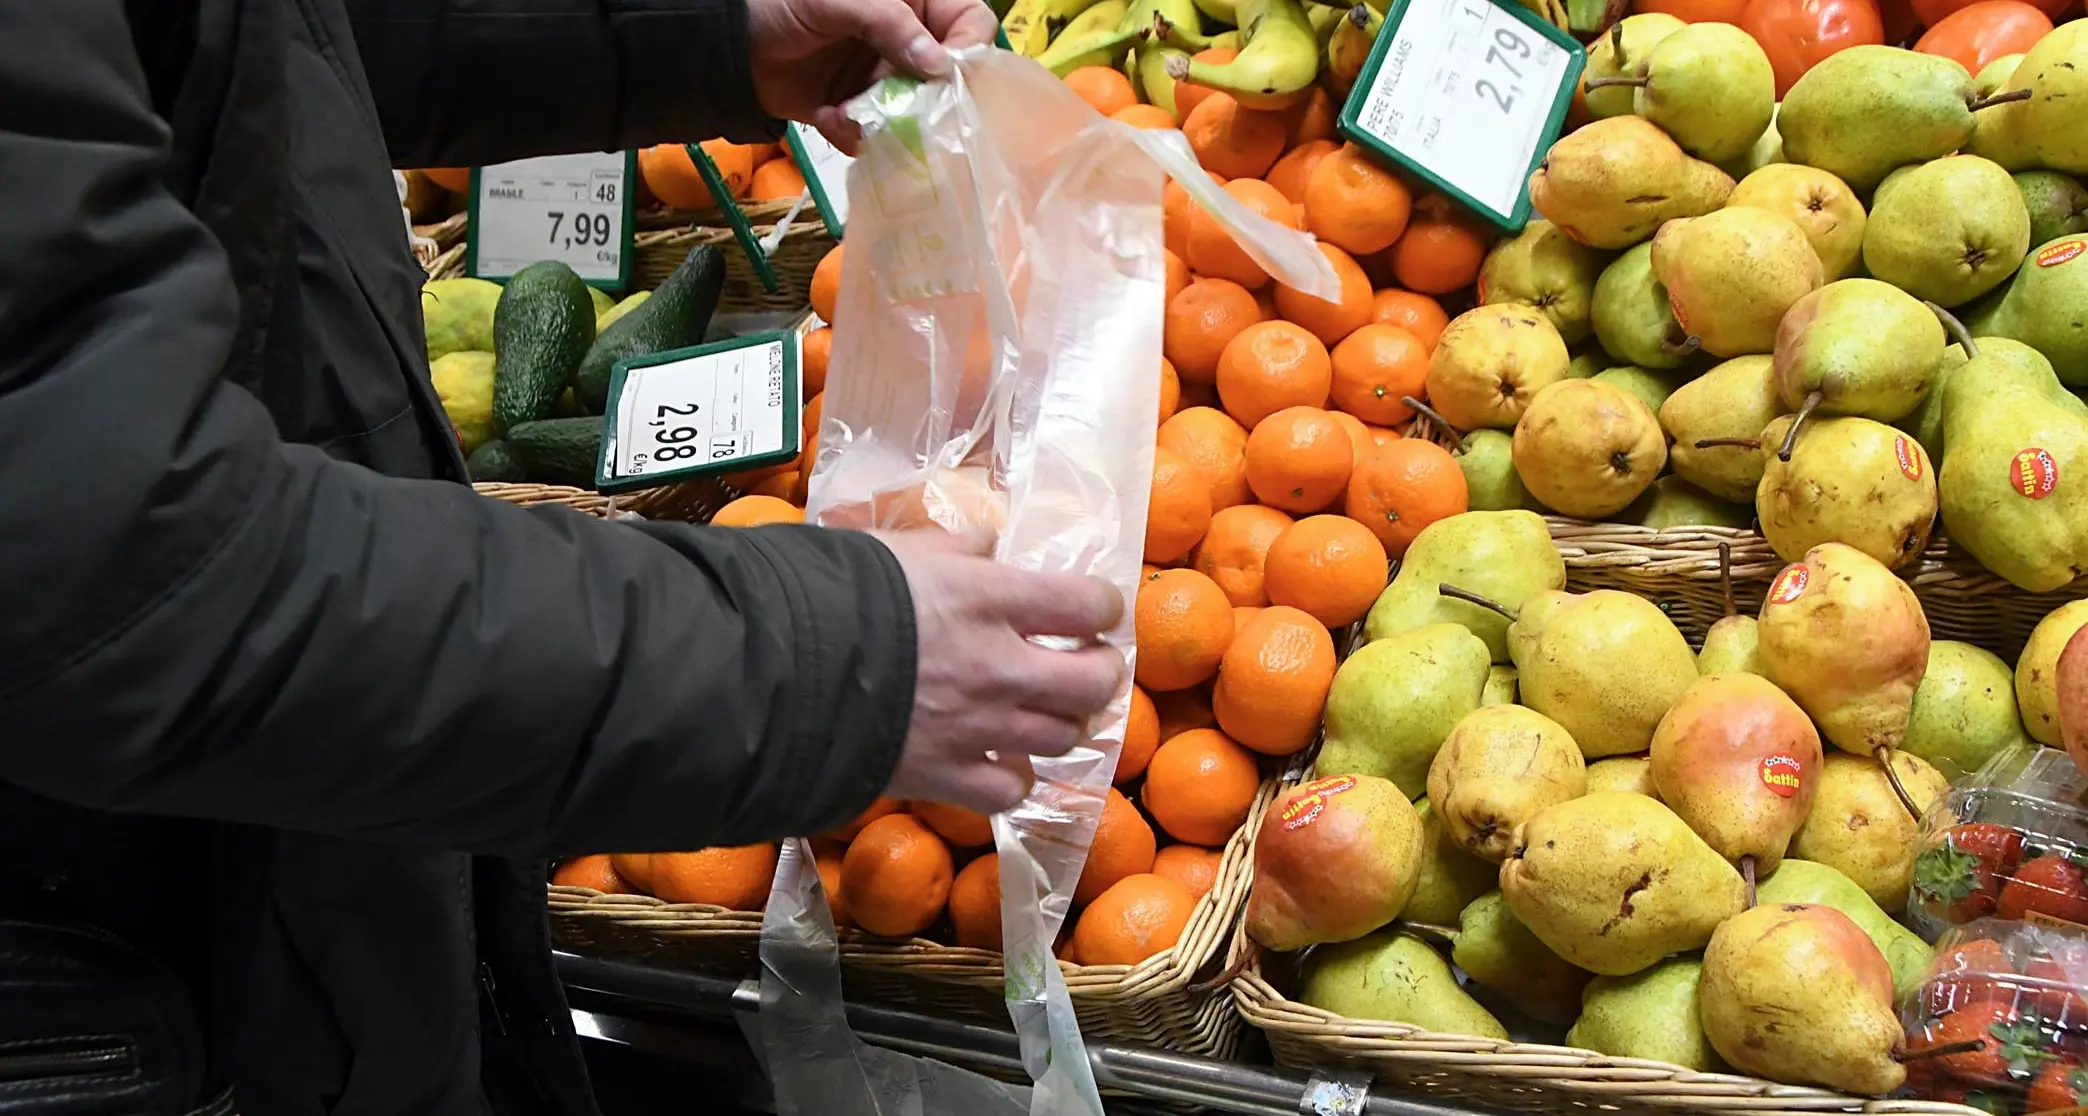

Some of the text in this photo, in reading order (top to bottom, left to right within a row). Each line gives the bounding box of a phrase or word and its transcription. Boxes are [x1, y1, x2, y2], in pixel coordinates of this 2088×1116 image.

[1367, 37, 1413, 132] PERE WILLIAMS
[1475, 27, 1531, 115] 2,79
[1423, 115, 1442, 150] ITALIA
[489, 187, 524, 199] BRASILE
[596, 183, 616, 202] 48
[547, 211, 611, 251] 7,99
[596, 250, 618, 266] €/kg
[767, 344, 781, 408] MELONE RETATO
[648, 403, 699, 462] 2,98
[712, 439, 736, 458] 78
[628, 453, 648, 474] €/kg
